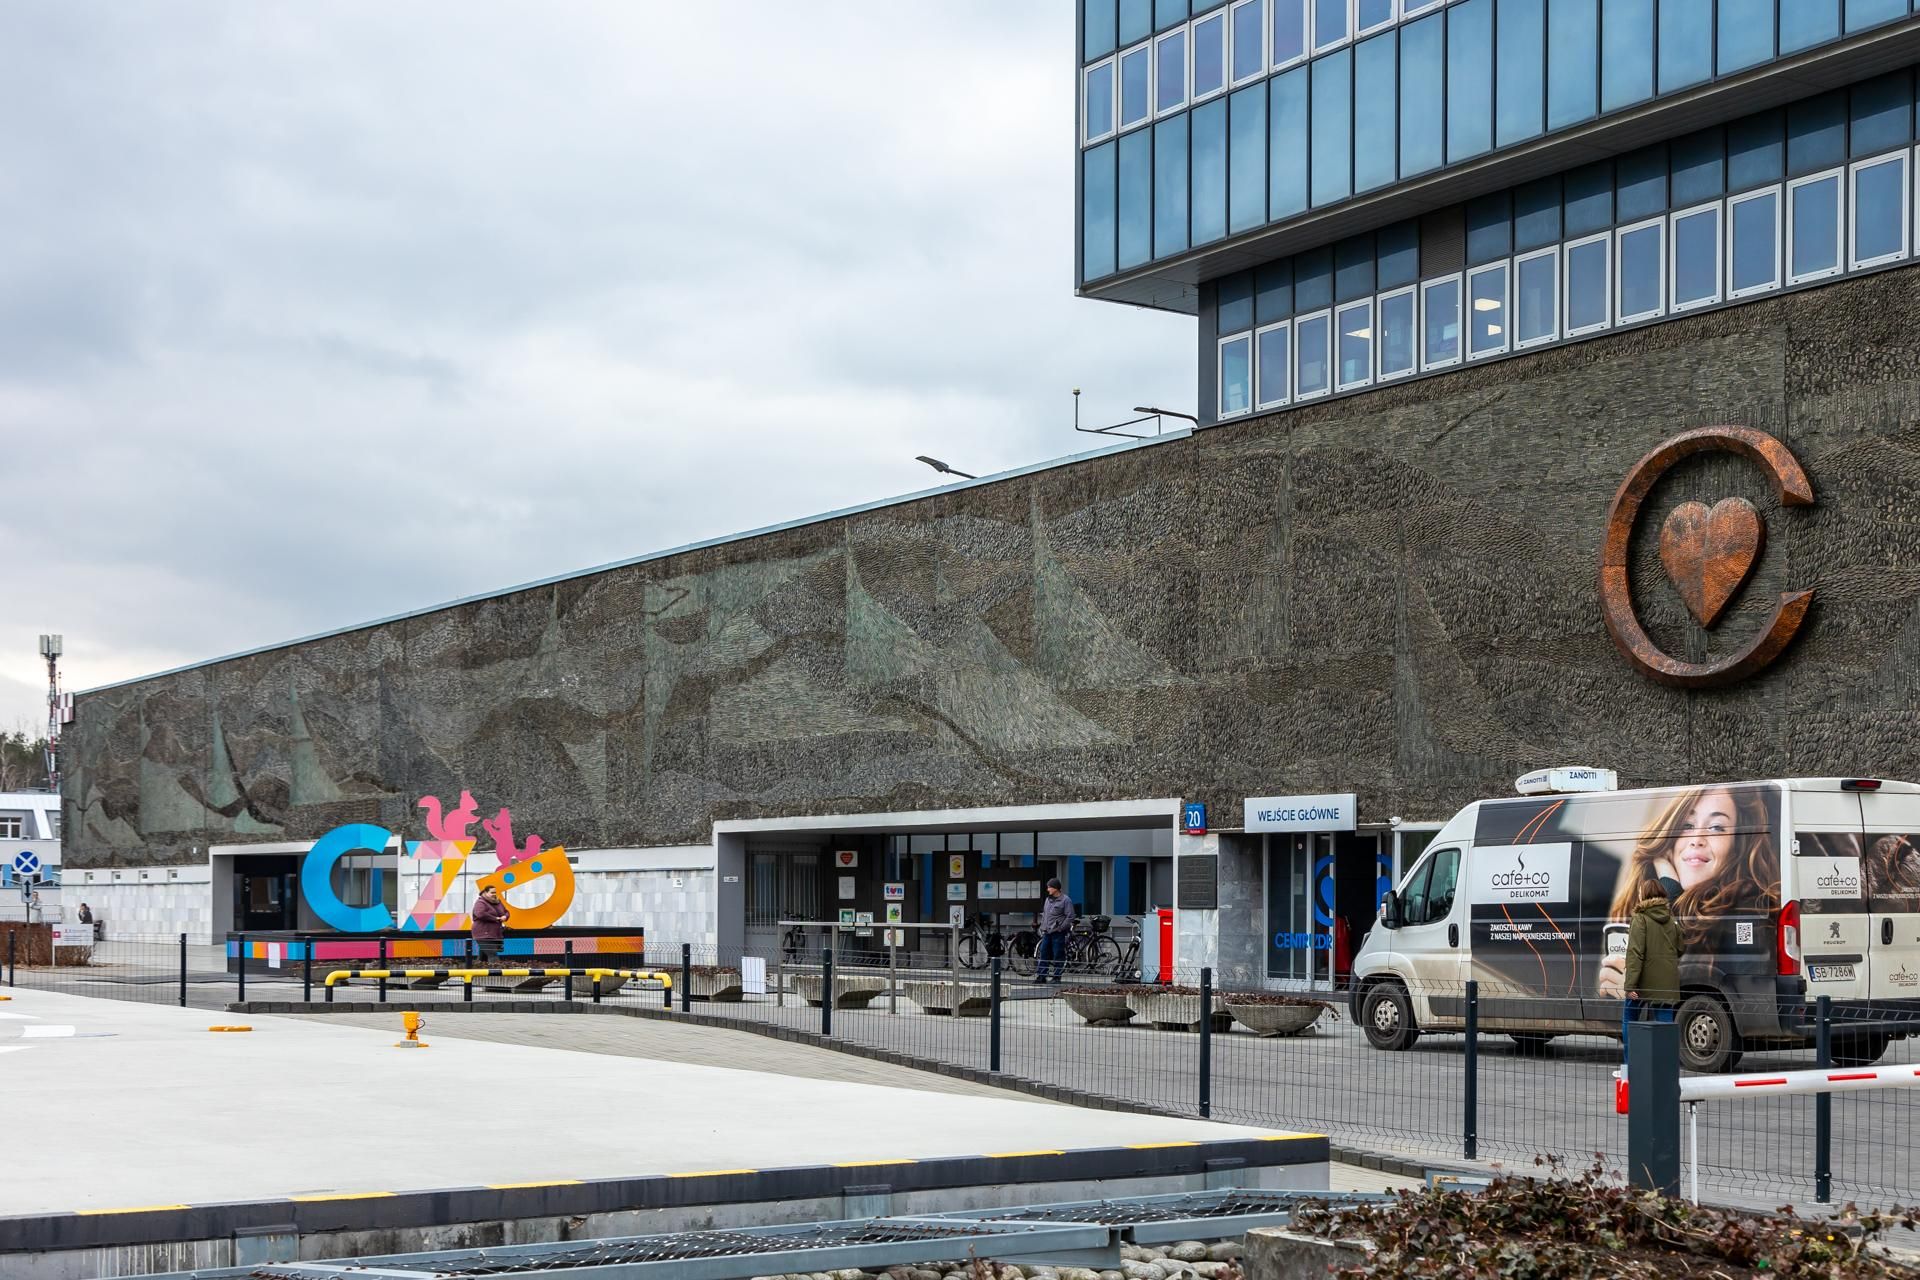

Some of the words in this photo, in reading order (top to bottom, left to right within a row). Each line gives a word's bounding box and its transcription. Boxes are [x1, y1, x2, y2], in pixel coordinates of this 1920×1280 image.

[1569, 771, 1597, 780] ZANOTTI
[1523, 777, 1543, 785] ZANOTTI
[1188, 810, 1201, 827] 20
[1257, 808, 1296, 822] WEJŚCIE
[1298, 806, 1340, 821] GŁÓWNE
[1510, 890, 1549, 898] DELIKOMAT
[1518, 923, 1533, 931] KAWY
[1494, 932, 1512, 941] NASZEJ
[1814, 967, 1828, 978] SB
